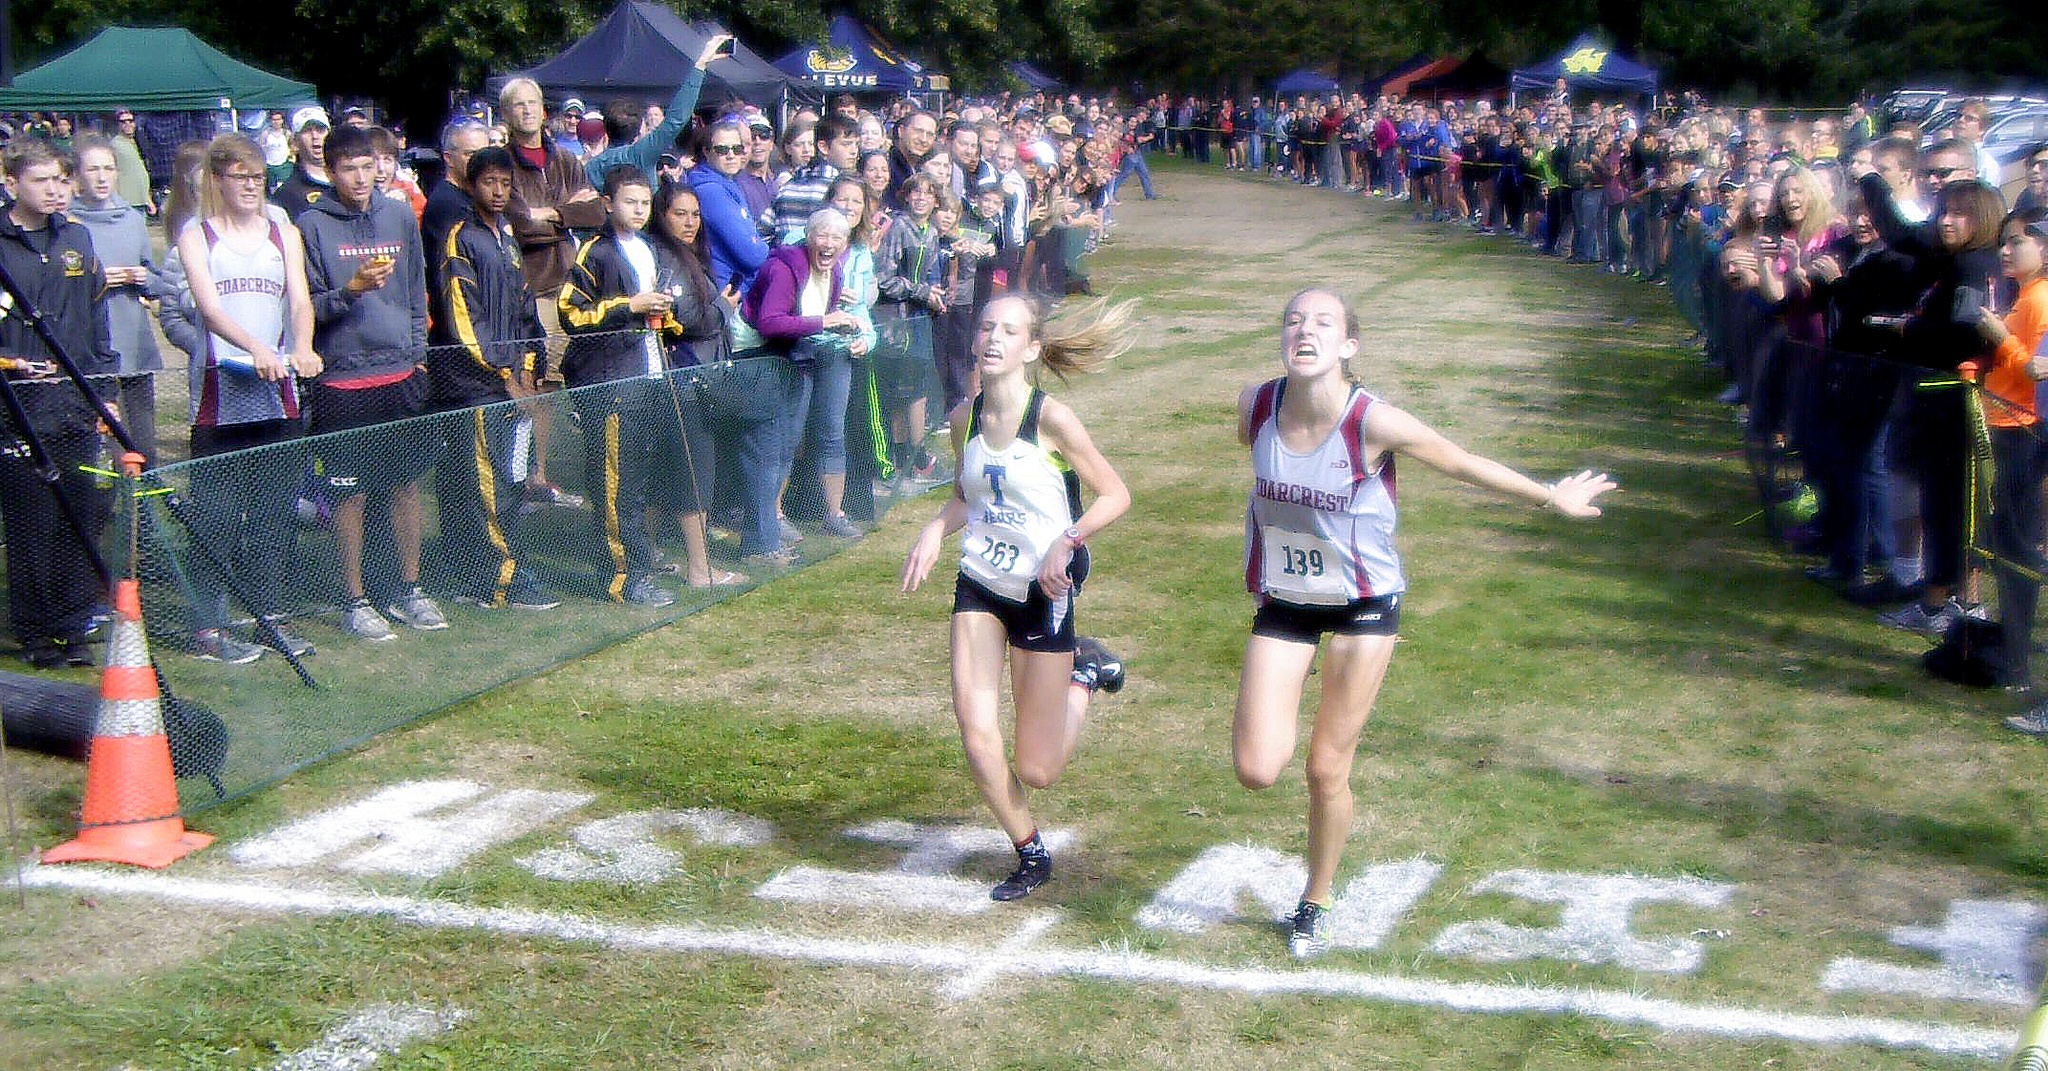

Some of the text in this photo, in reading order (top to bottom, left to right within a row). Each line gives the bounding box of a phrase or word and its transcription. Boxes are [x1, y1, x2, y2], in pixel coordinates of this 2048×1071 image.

[801, 74, 878, 87] EVUE
[983, 464, 1006, 506] T
[980, 535, 1020, 572] 263
[1282, 545, 1324, 577] 139
